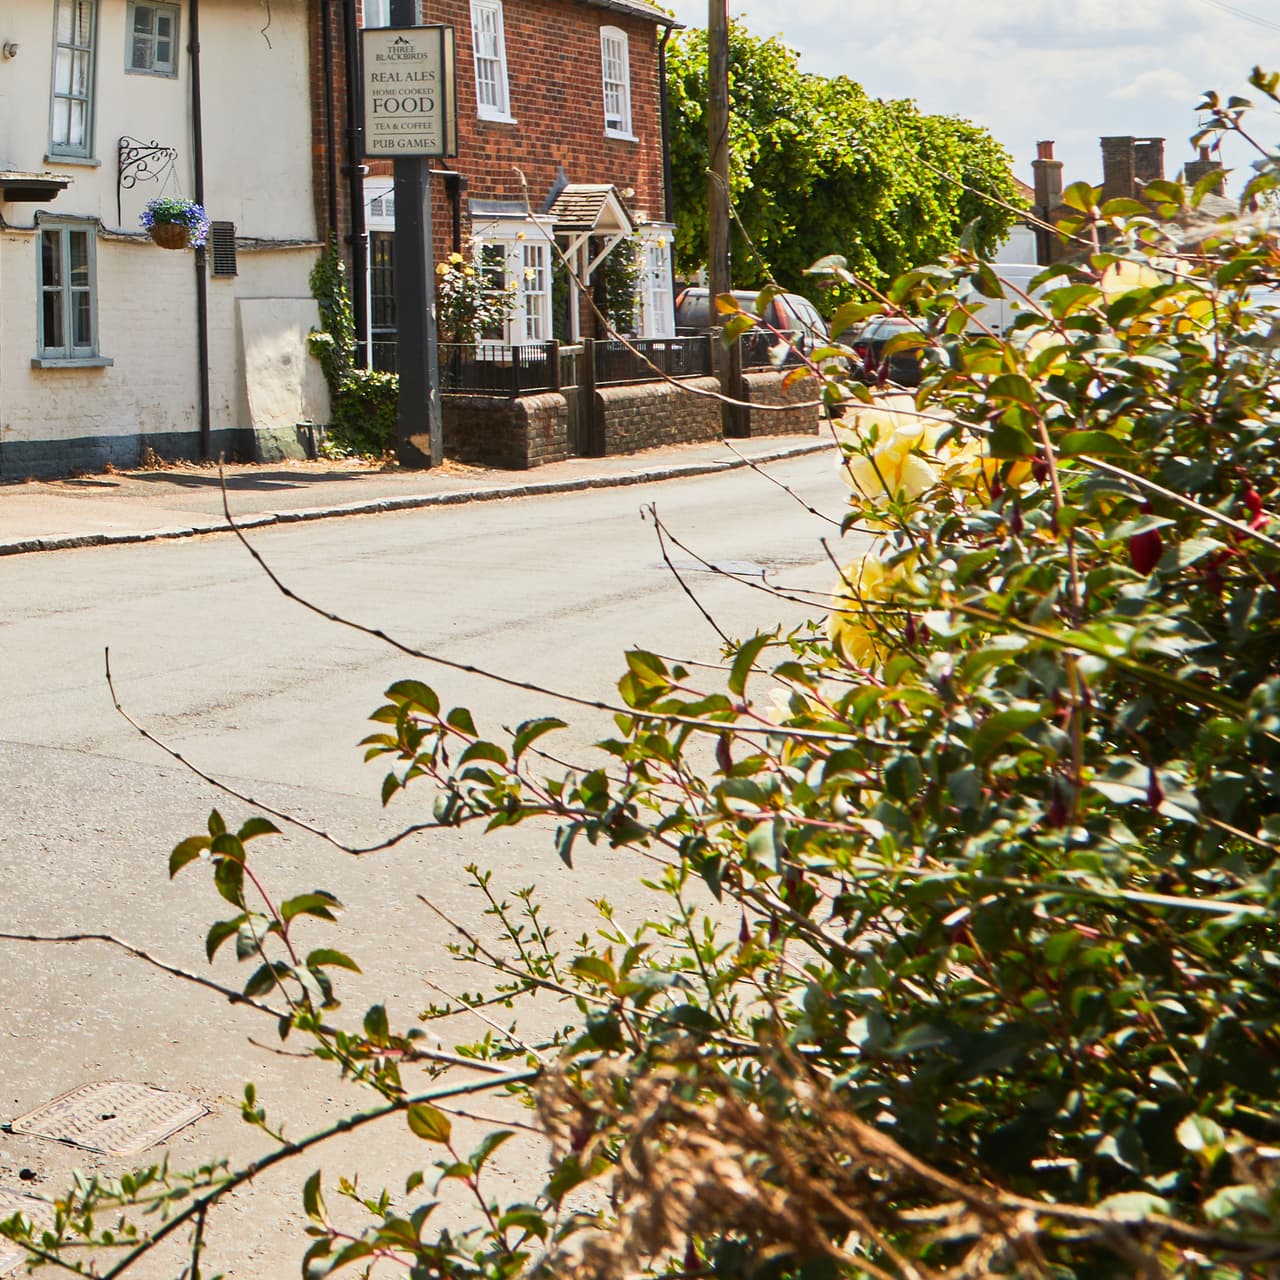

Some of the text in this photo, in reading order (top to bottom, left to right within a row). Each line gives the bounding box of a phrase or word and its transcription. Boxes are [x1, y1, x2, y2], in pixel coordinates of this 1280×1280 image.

[376, 53, 428, 61] BLACKBIRDS
[371, 71, 435, 82] REAL ALES
[372, 97, 434, 113] FOOD
[375, 122, 391, 130] TEA
[373, 138, 436, 148] PUB GAMES
